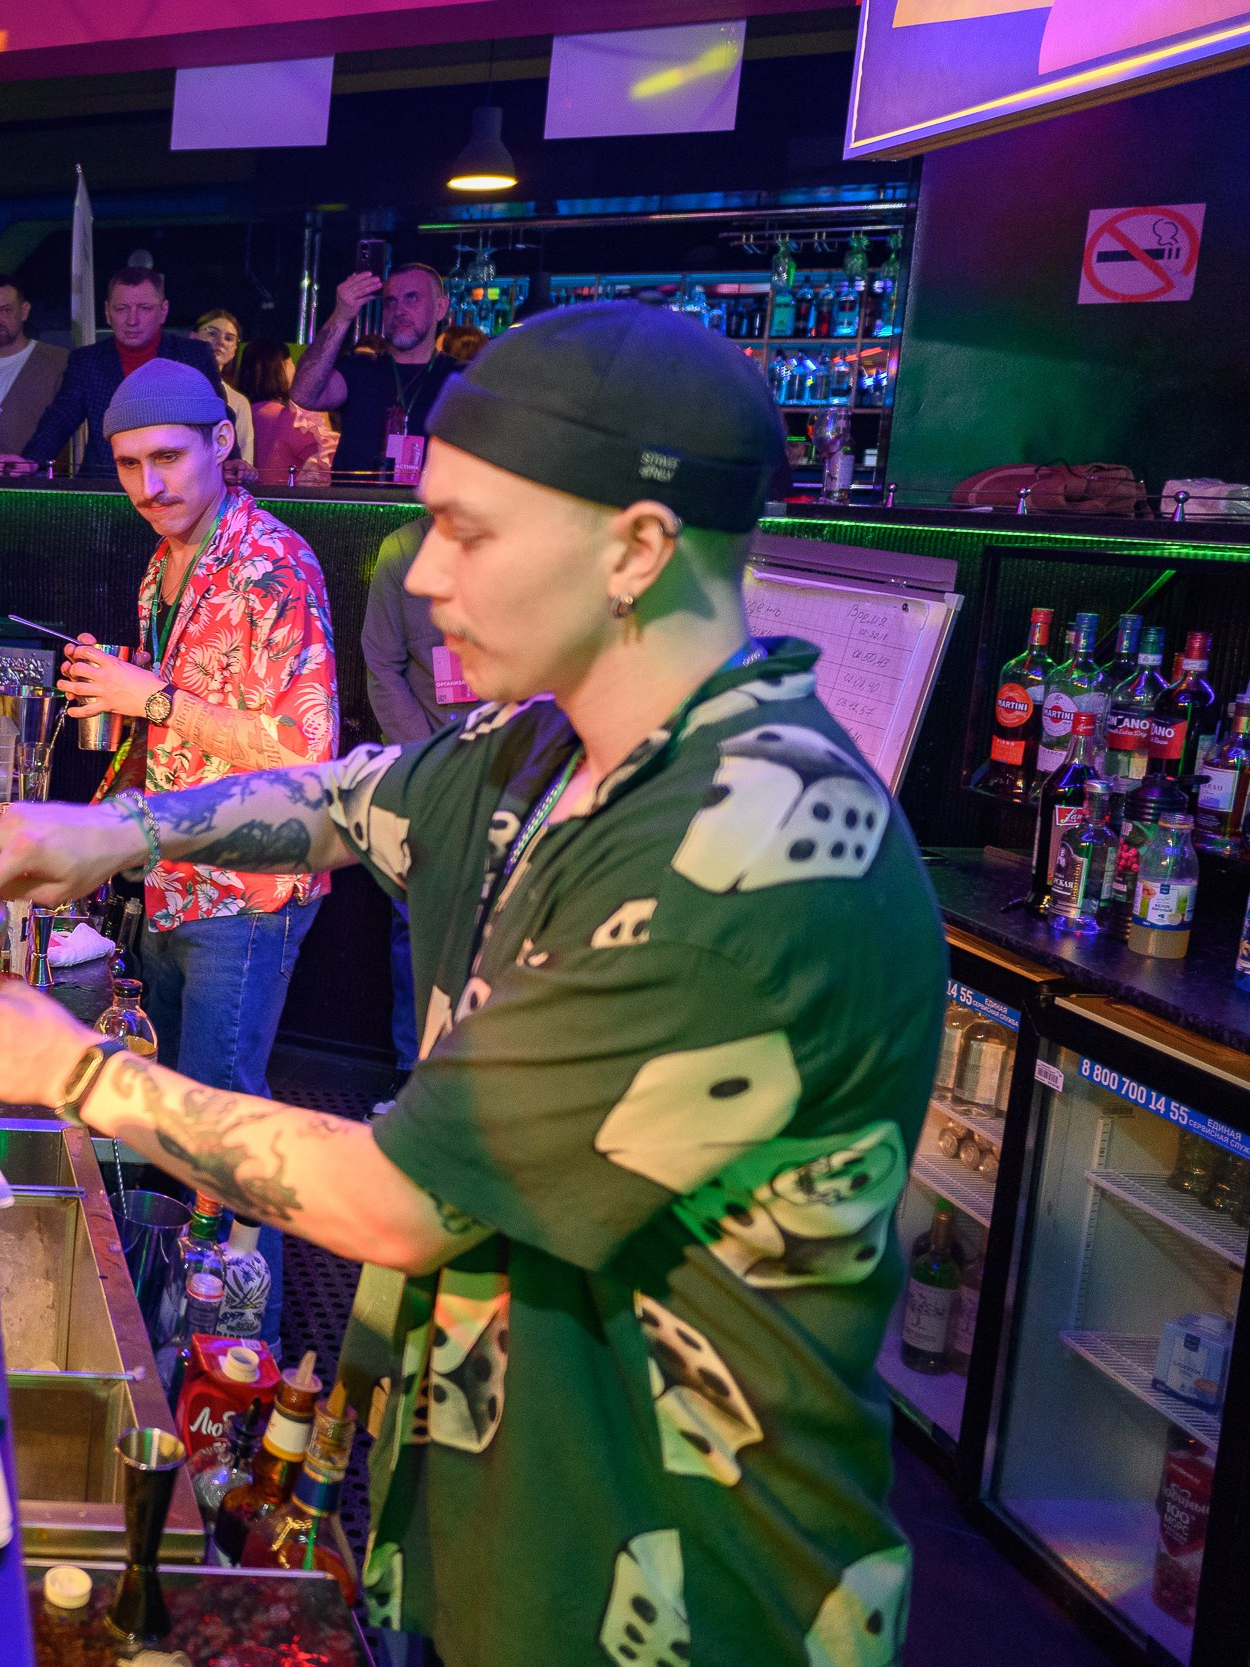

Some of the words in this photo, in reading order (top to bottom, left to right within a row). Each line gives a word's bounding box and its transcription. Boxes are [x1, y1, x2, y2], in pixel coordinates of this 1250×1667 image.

[997, 699, 1028, 711] MARTINI
[1044, 707, 1074, 721] MARTINI
[959, 986, 974, 1006] 55
[1081, 1059, 1090, 1076] 8
[1093, 1064, 1119, 1090] 800
[1121, 1077, 1147, 1104] 700
[1149, 1091, 1166, 1114] 14
[1170, 1101, 1190, 1125] 55
[1189, 1119, 1229, 1144] СЕРВИСНАЯ
[1207, 1119, 1242, 1142] ЕДИНАЯ
